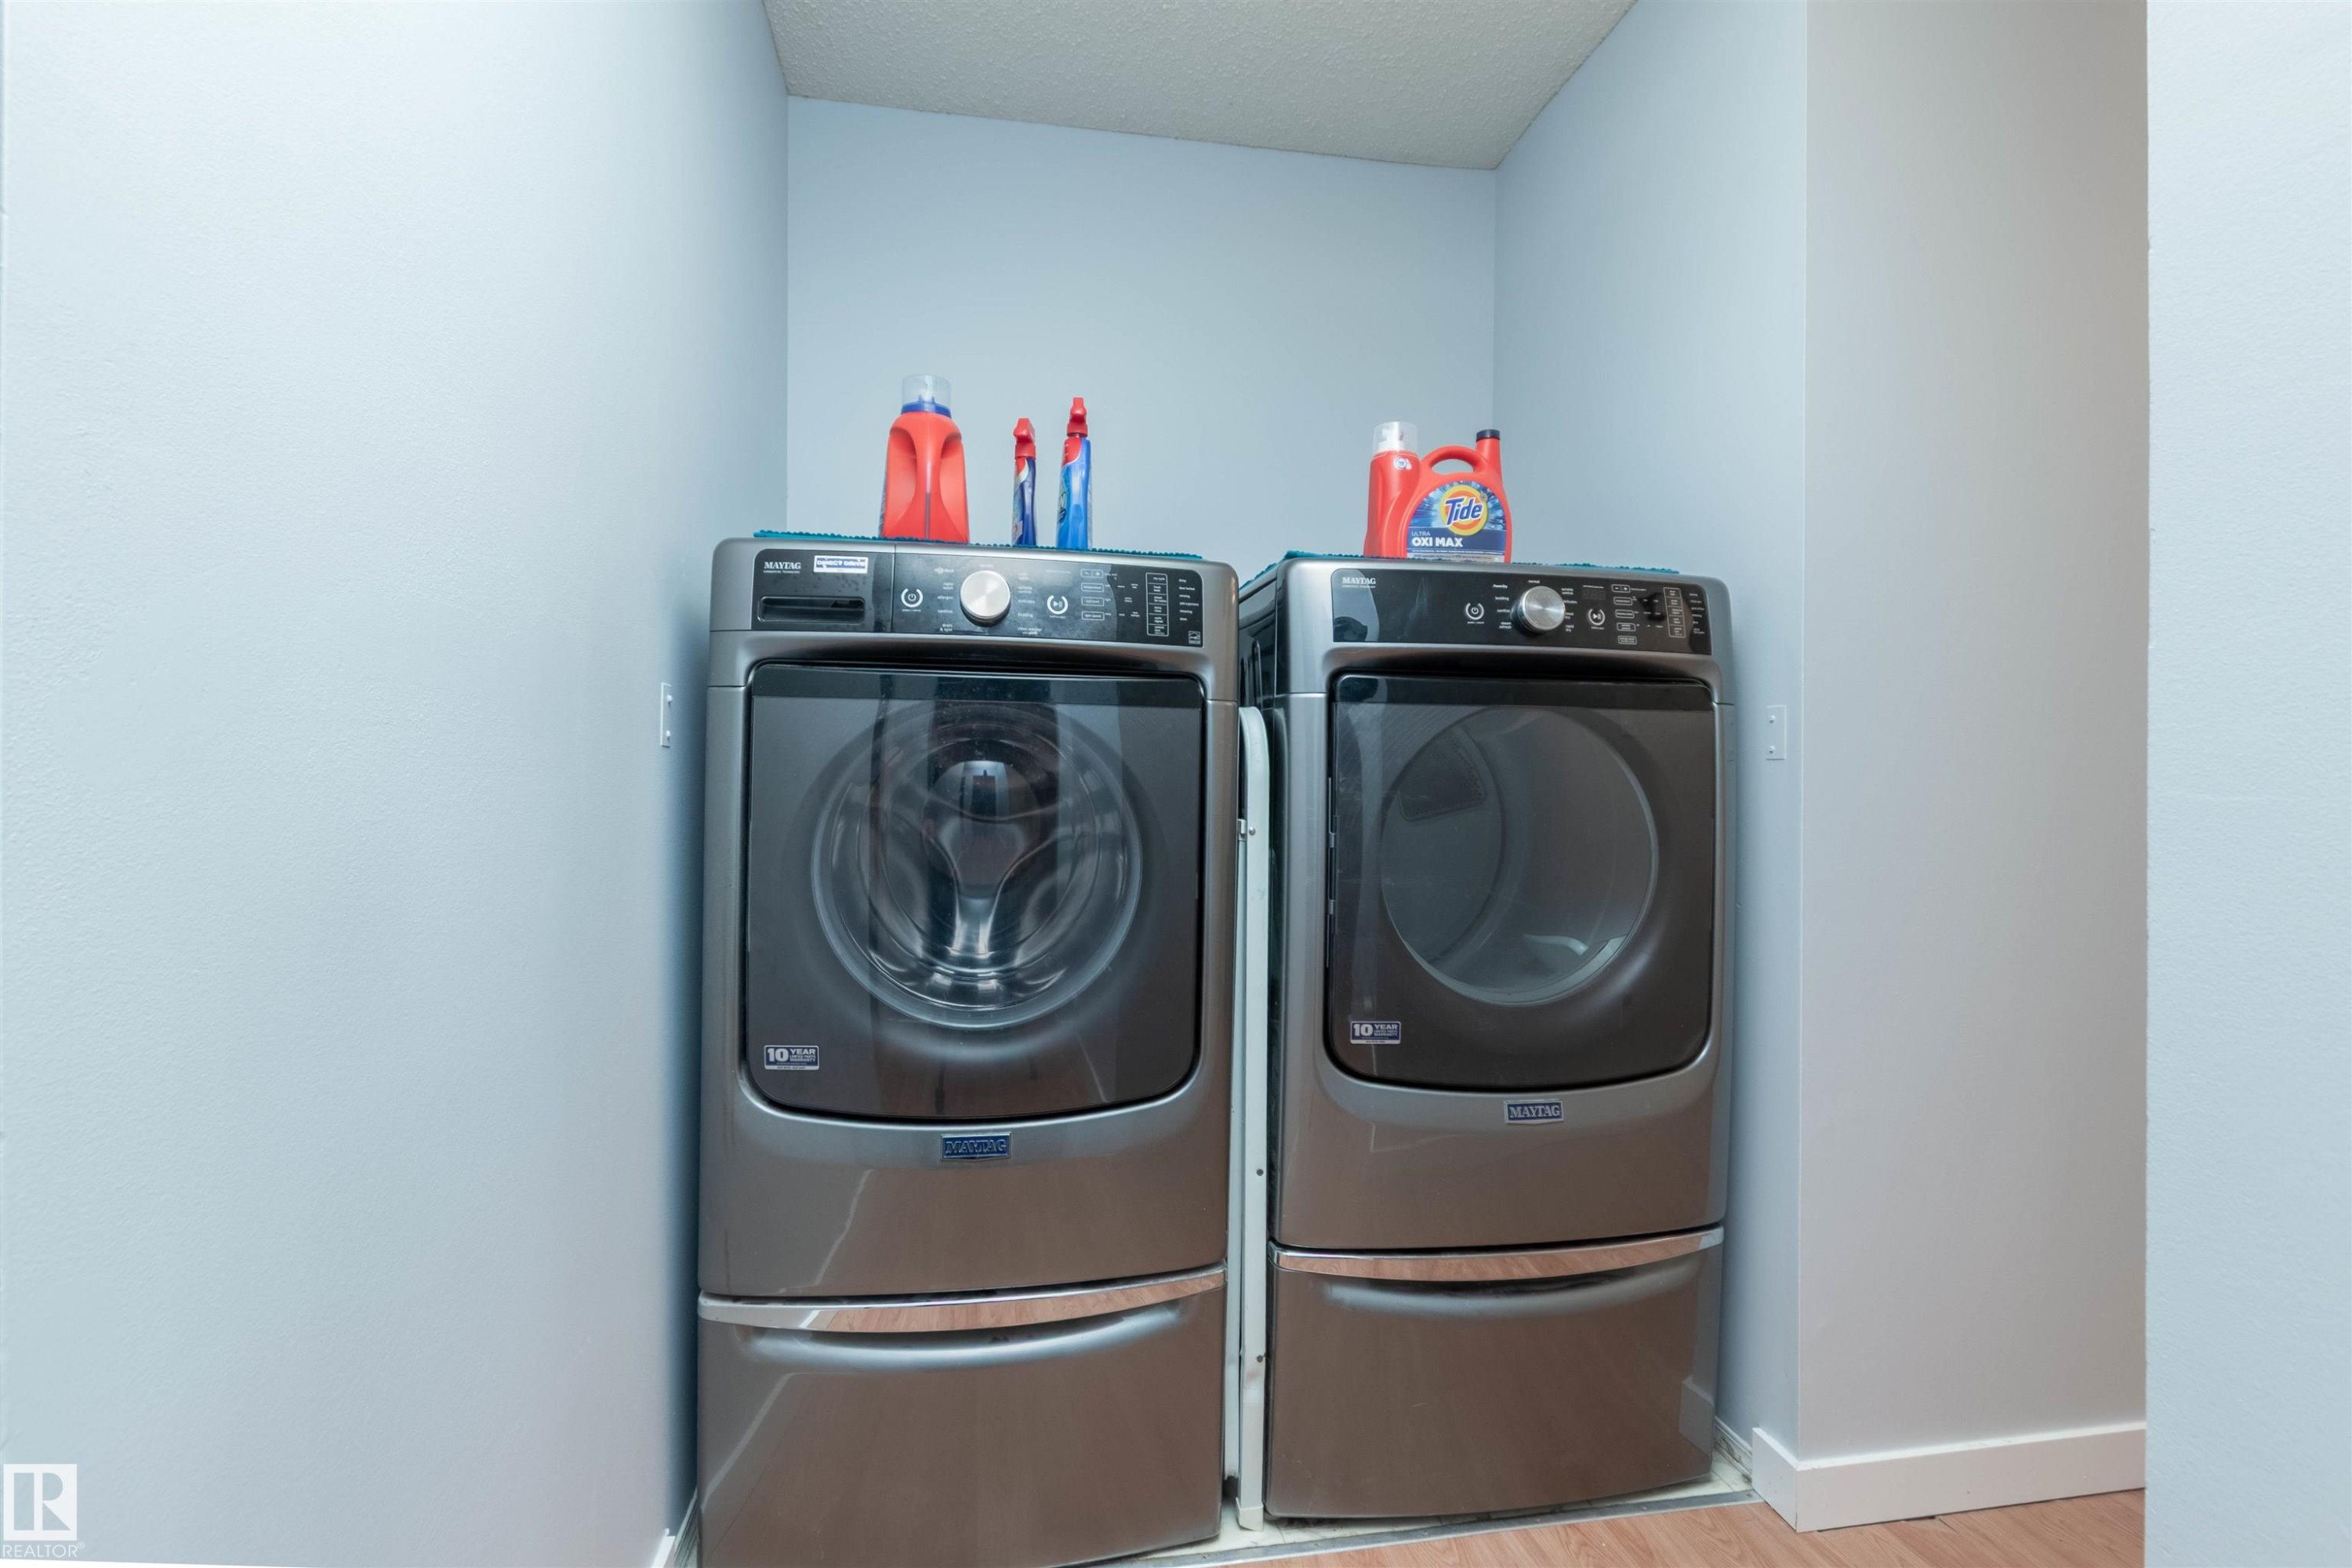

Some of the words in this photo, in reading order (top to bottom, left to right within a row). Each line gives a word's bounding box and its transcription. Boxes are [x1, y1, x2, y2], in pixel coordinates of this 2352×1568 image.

[1445, 497, 1483, 526] Tide
[1411, 537, 1433, 547] OXI
[1436, 537, 1464, 547] MAX
[764, 561, 801, 570] MAYTAG
[1353, 1023, 1374, 1036] 10
[767, 1047, 789, 1062] 10
[1509, 1105, 1561, 1119] MAYTAG
[946, 1138, 1007, 1154] MAYTAG
